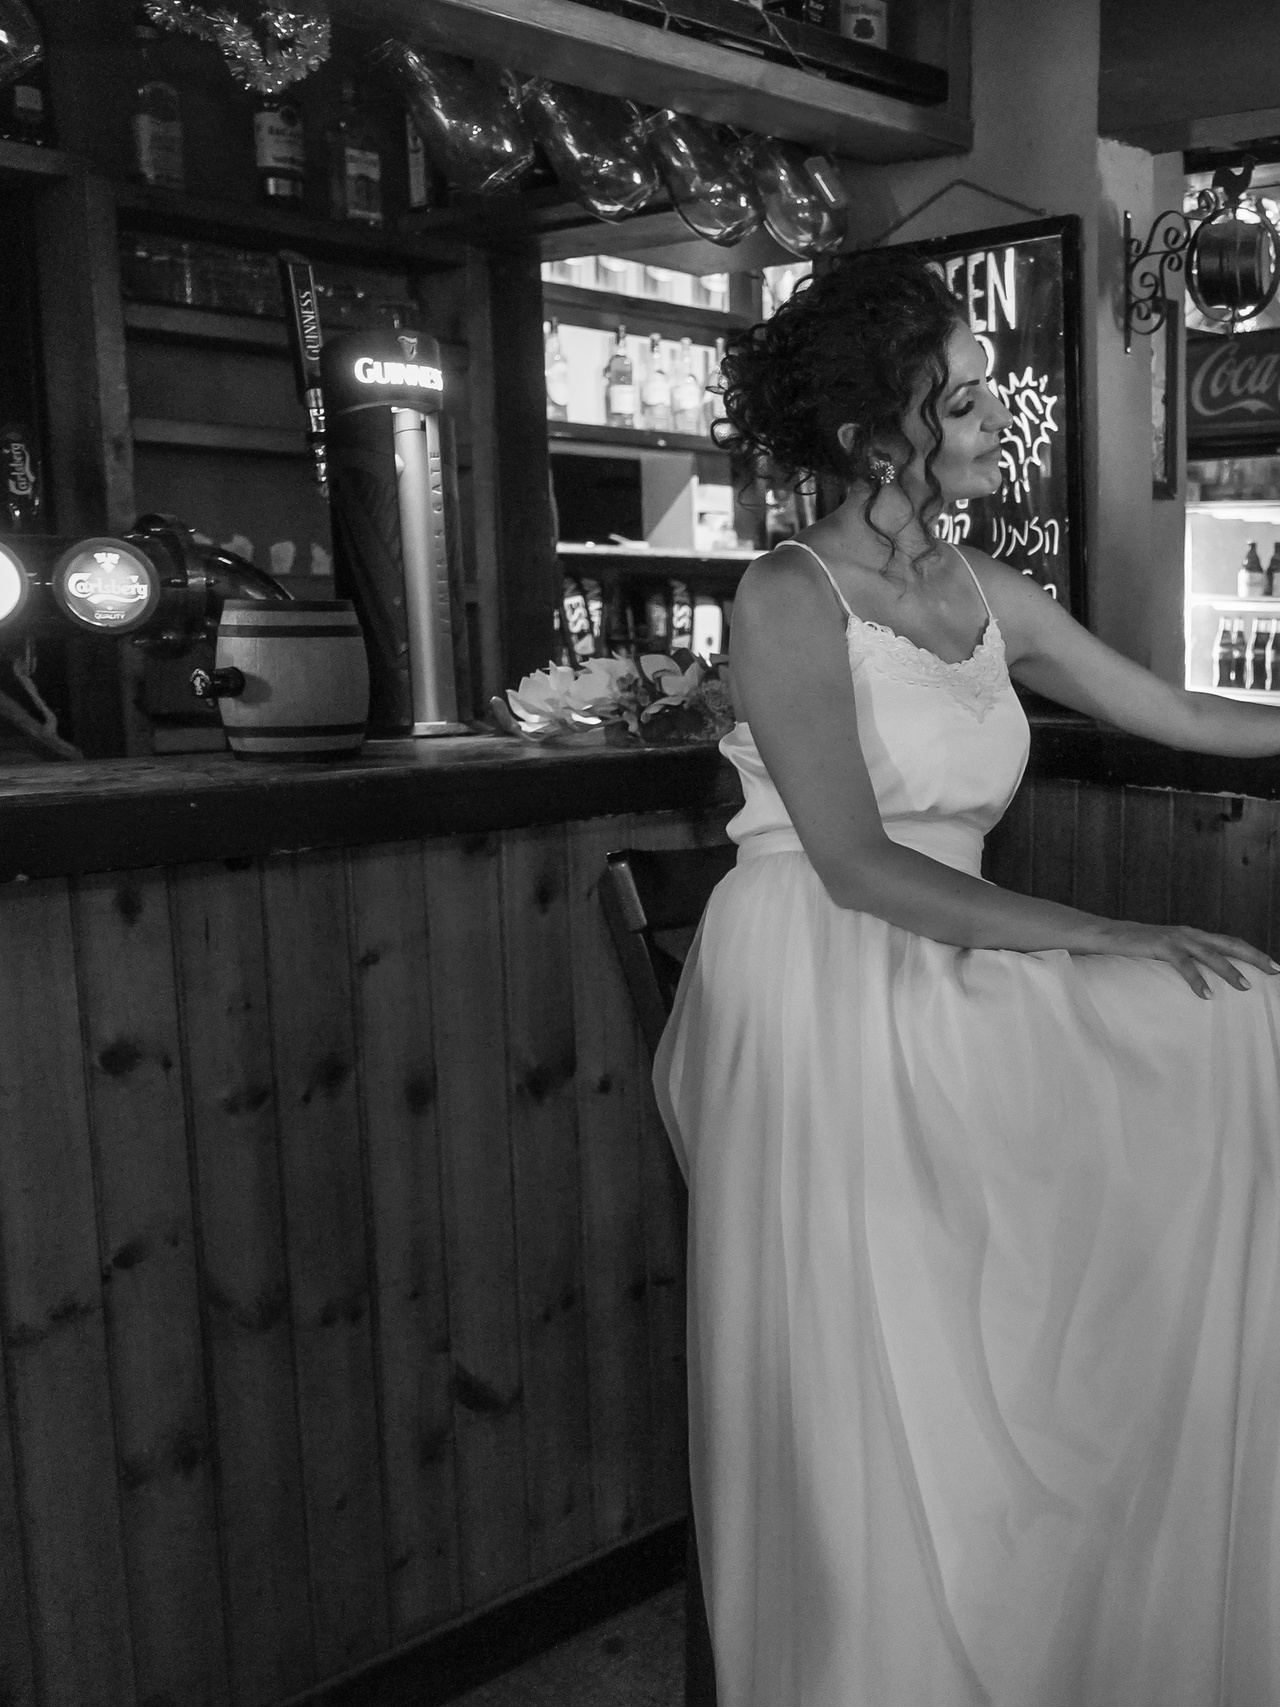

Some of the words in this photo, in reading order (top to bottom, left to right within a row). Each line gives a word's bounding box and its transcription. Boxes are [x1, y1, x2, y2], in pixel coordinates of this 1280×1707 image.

[300, 291, 320, 361] GUINNESS
[355, 357, 443, 391] GUINNES
[8, 443, 35, 495] Carlsberg
[992, 516, 1060, 559] הזמינו
[68, 572, 148, 605] Carlsberg
